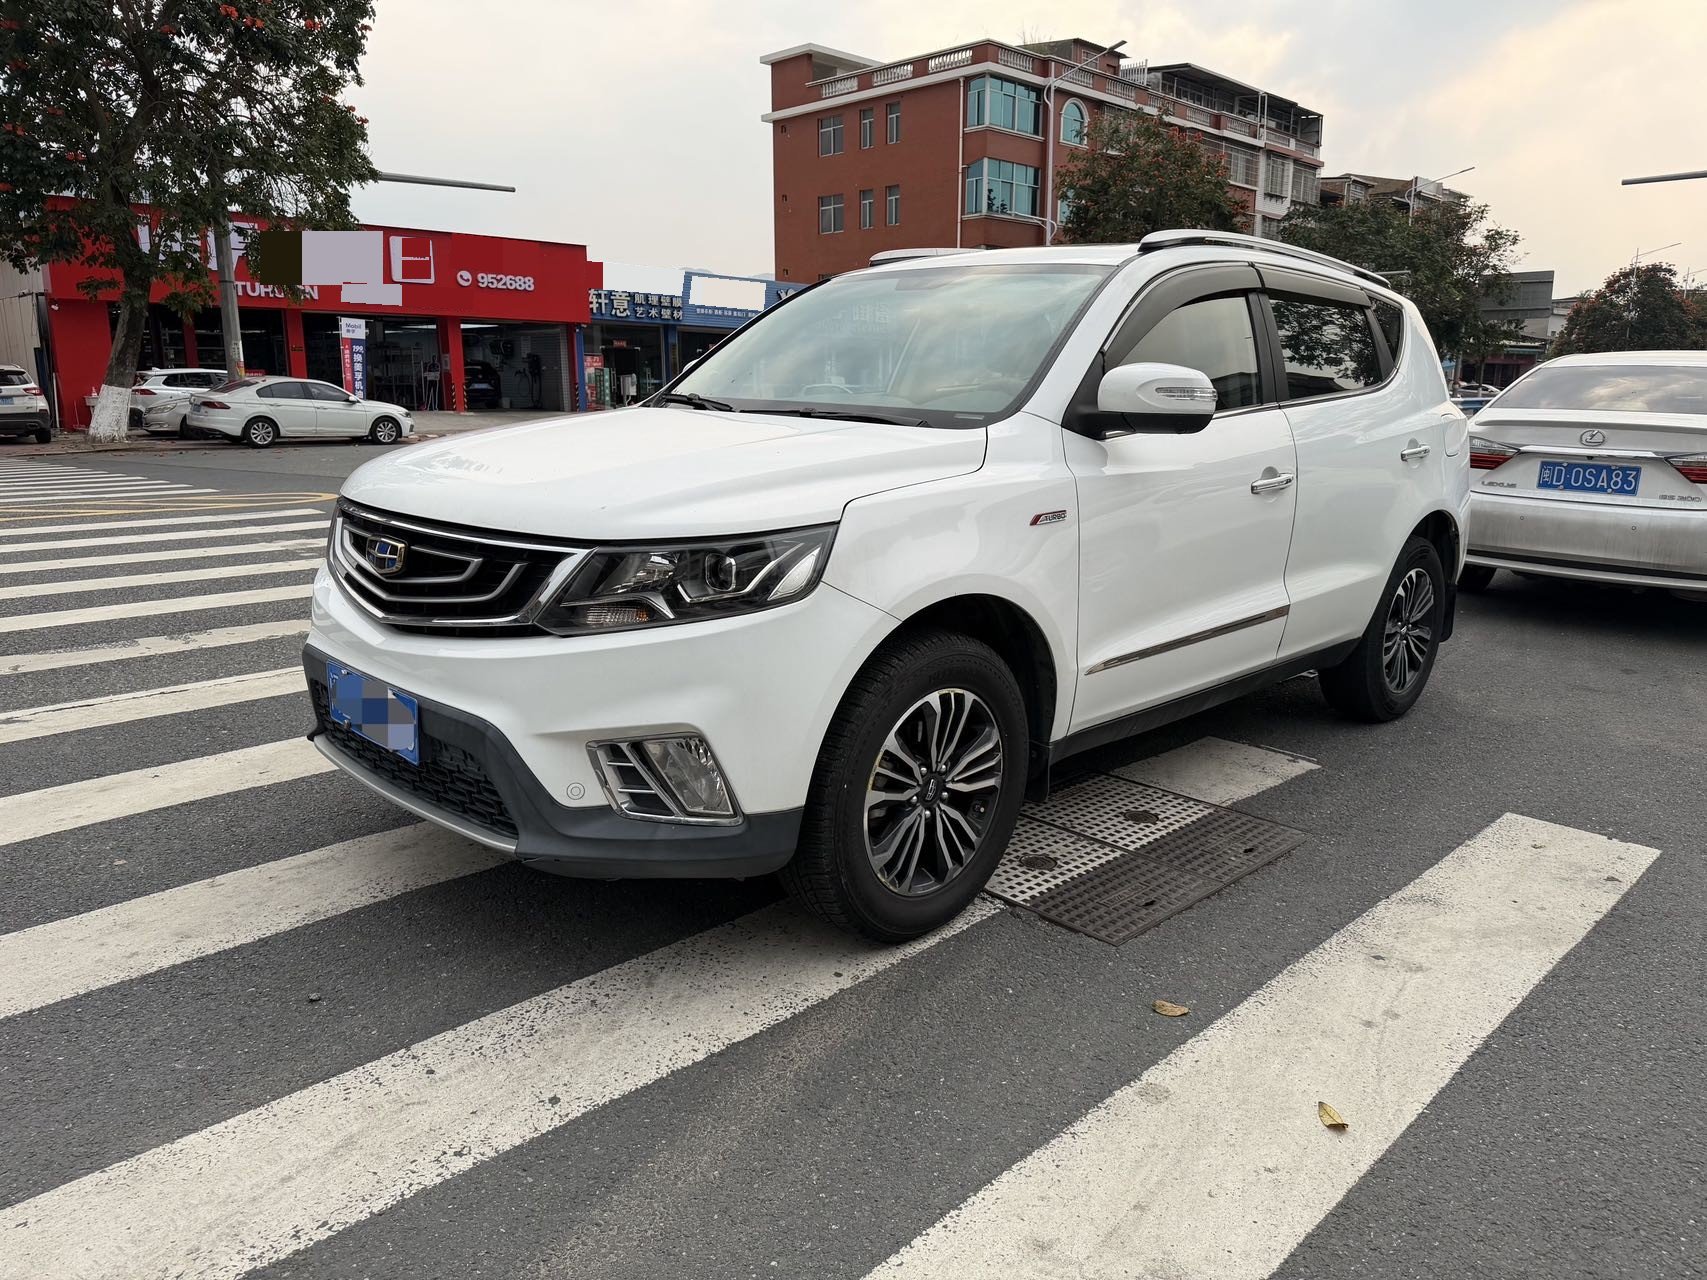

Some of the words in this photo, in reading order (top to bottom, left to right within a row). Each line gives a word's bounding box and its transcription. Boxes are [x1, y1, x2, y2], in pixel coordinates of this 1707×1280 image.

[477, 272, 535, 292] 952688
[588, 288, 631, 317] 轩意
[634, 293, 683, 308] 肌理壁膜
[634, 306, 683, 321] 艺术壁材
[345, 322, 362, 330] Mobil
[1044, 513, 1066, 522] TURBO
